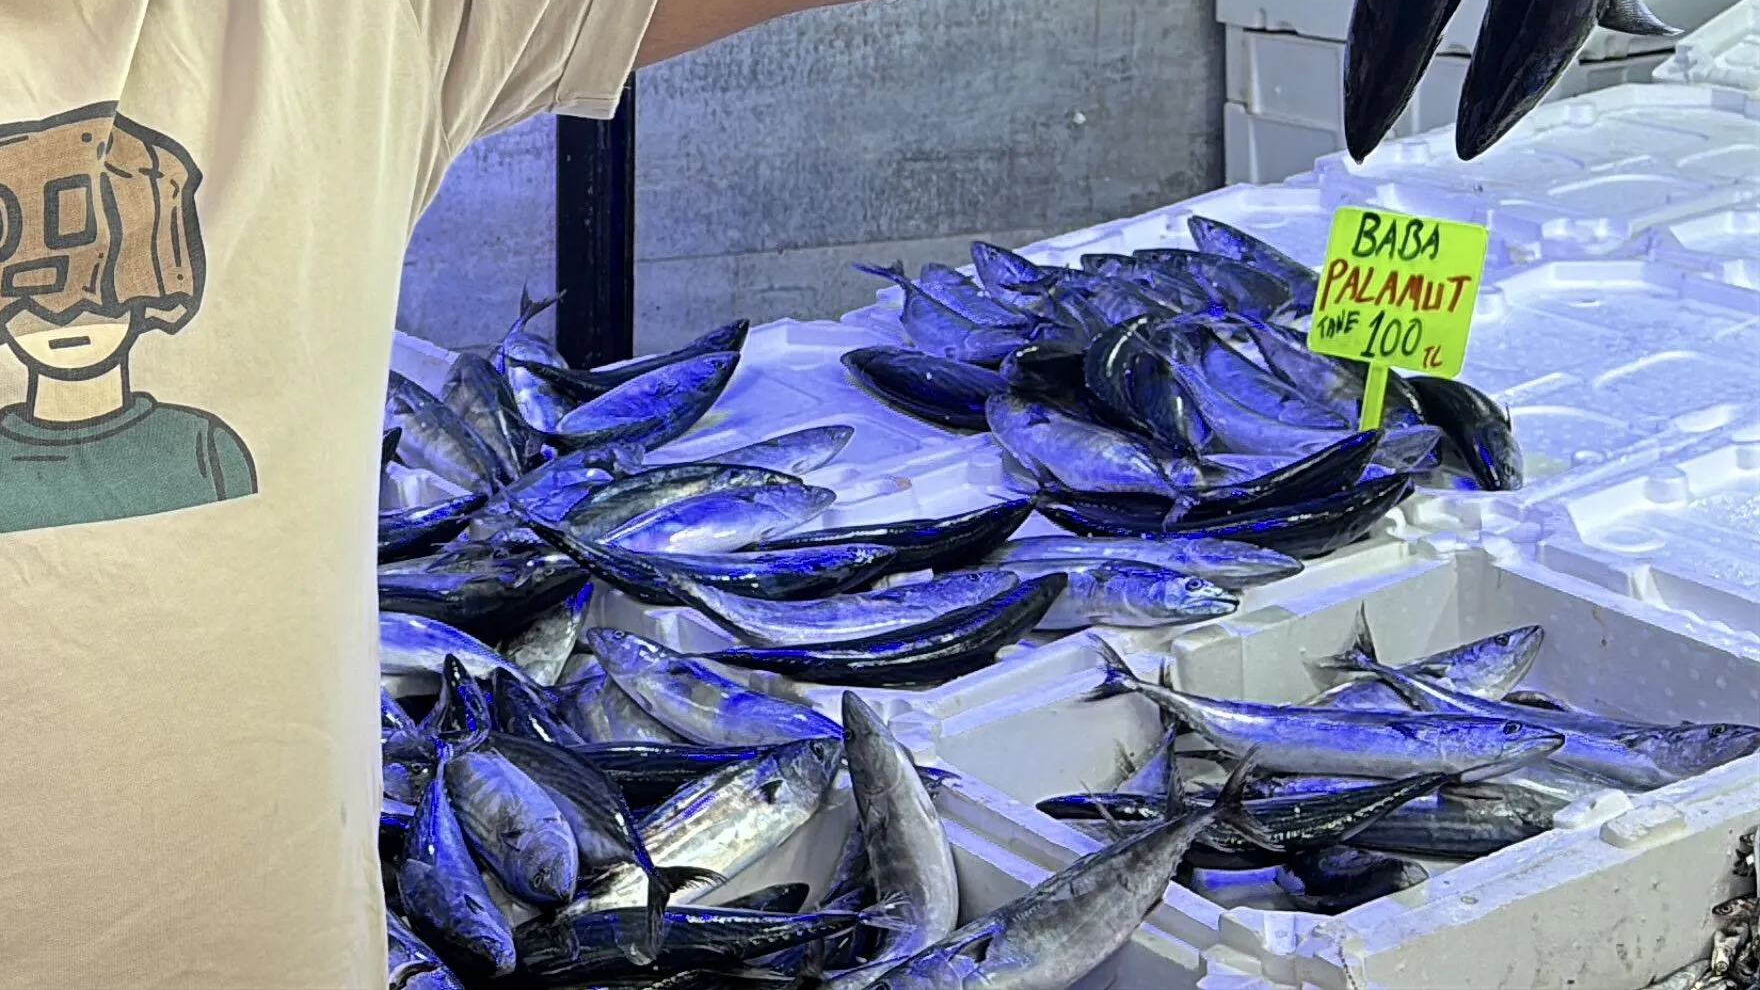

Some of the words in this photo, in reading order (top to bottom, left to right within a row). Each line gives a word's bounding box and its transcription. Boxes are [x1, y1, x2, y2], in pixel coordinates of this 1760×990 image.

[1352, 212, 1440, 261] BABA
[1319, 258, 1472, 313] PALAMUT
[1317, 309, 1361, 338] TANE
[1360, 310, 1423, 358] 100
[1423, 345, 1443, 368] TL
